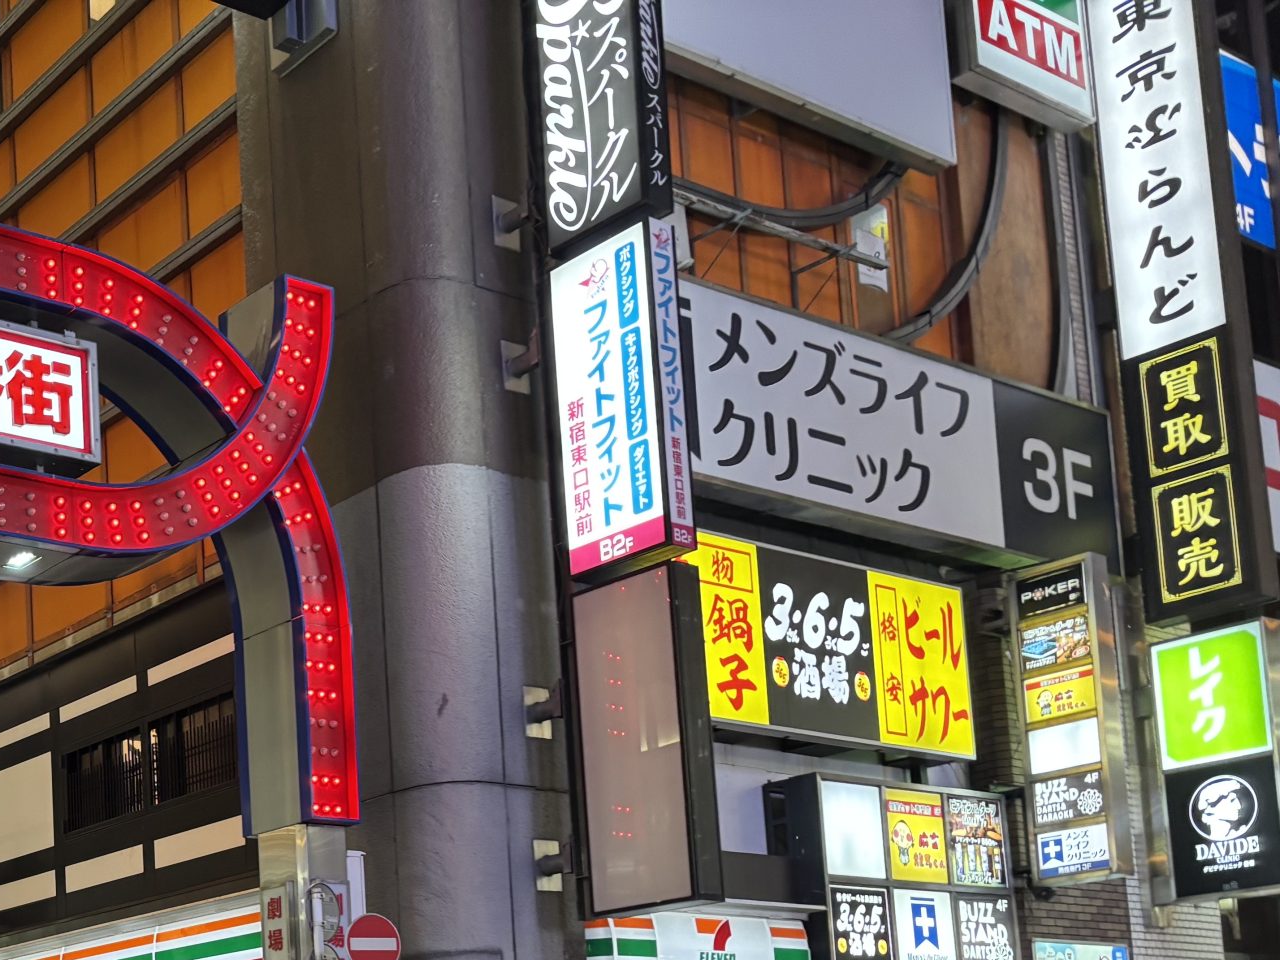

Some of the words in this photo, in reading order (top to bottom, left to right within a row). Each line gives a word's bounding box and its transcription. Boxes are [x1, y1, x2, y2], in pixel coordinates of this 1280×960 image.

[988, 0, 1079, 81] ATM
[586, 16, 638, 222] スパークル
[618, 245, 632, 319] ボクシング
[653, 250, 684, 433] ファイトフィット
[708, 312, 970, 438] メンズライフ
[583, 297, 624, 529] ファイトフィット
[624, 331, 644, 437] キックボクシング
[1159, 360, 1212, 456] 買取
[567, 396, 593, 537] 新宿東口駅前
[632, 446, 649, 510] ダイエット
[671, 436, 686, 521] 新宿東口駅前
[713, 398, 931, 513] クリニック
[1022, 437, 1095, 521] 3F
[598, 532, 634, 563] B2F
[1170, 487, 1224, 586] 販売
[880, 611, 902, 705] 格安
[901, 596, 962, 671] ビール
[792, 647, 849, 705] 酒場
[908, 675, 970, 745] サワー
[1188, 646, 1226, 743] レイク
[1034, 777, 1068, 795] BUZZ
[1035, 787, 1080, 808] STAND
[1037, 809, 1074, 824] KARAOKE
[1083, 771, 1099, 784] 4F
[1195, 836, 1260, 861] DAVIDE
[958, 900, 995, 924] BUZZ
[961, 921, 1008, 944] STAND
[996, 899, 1008, 912] 4F
